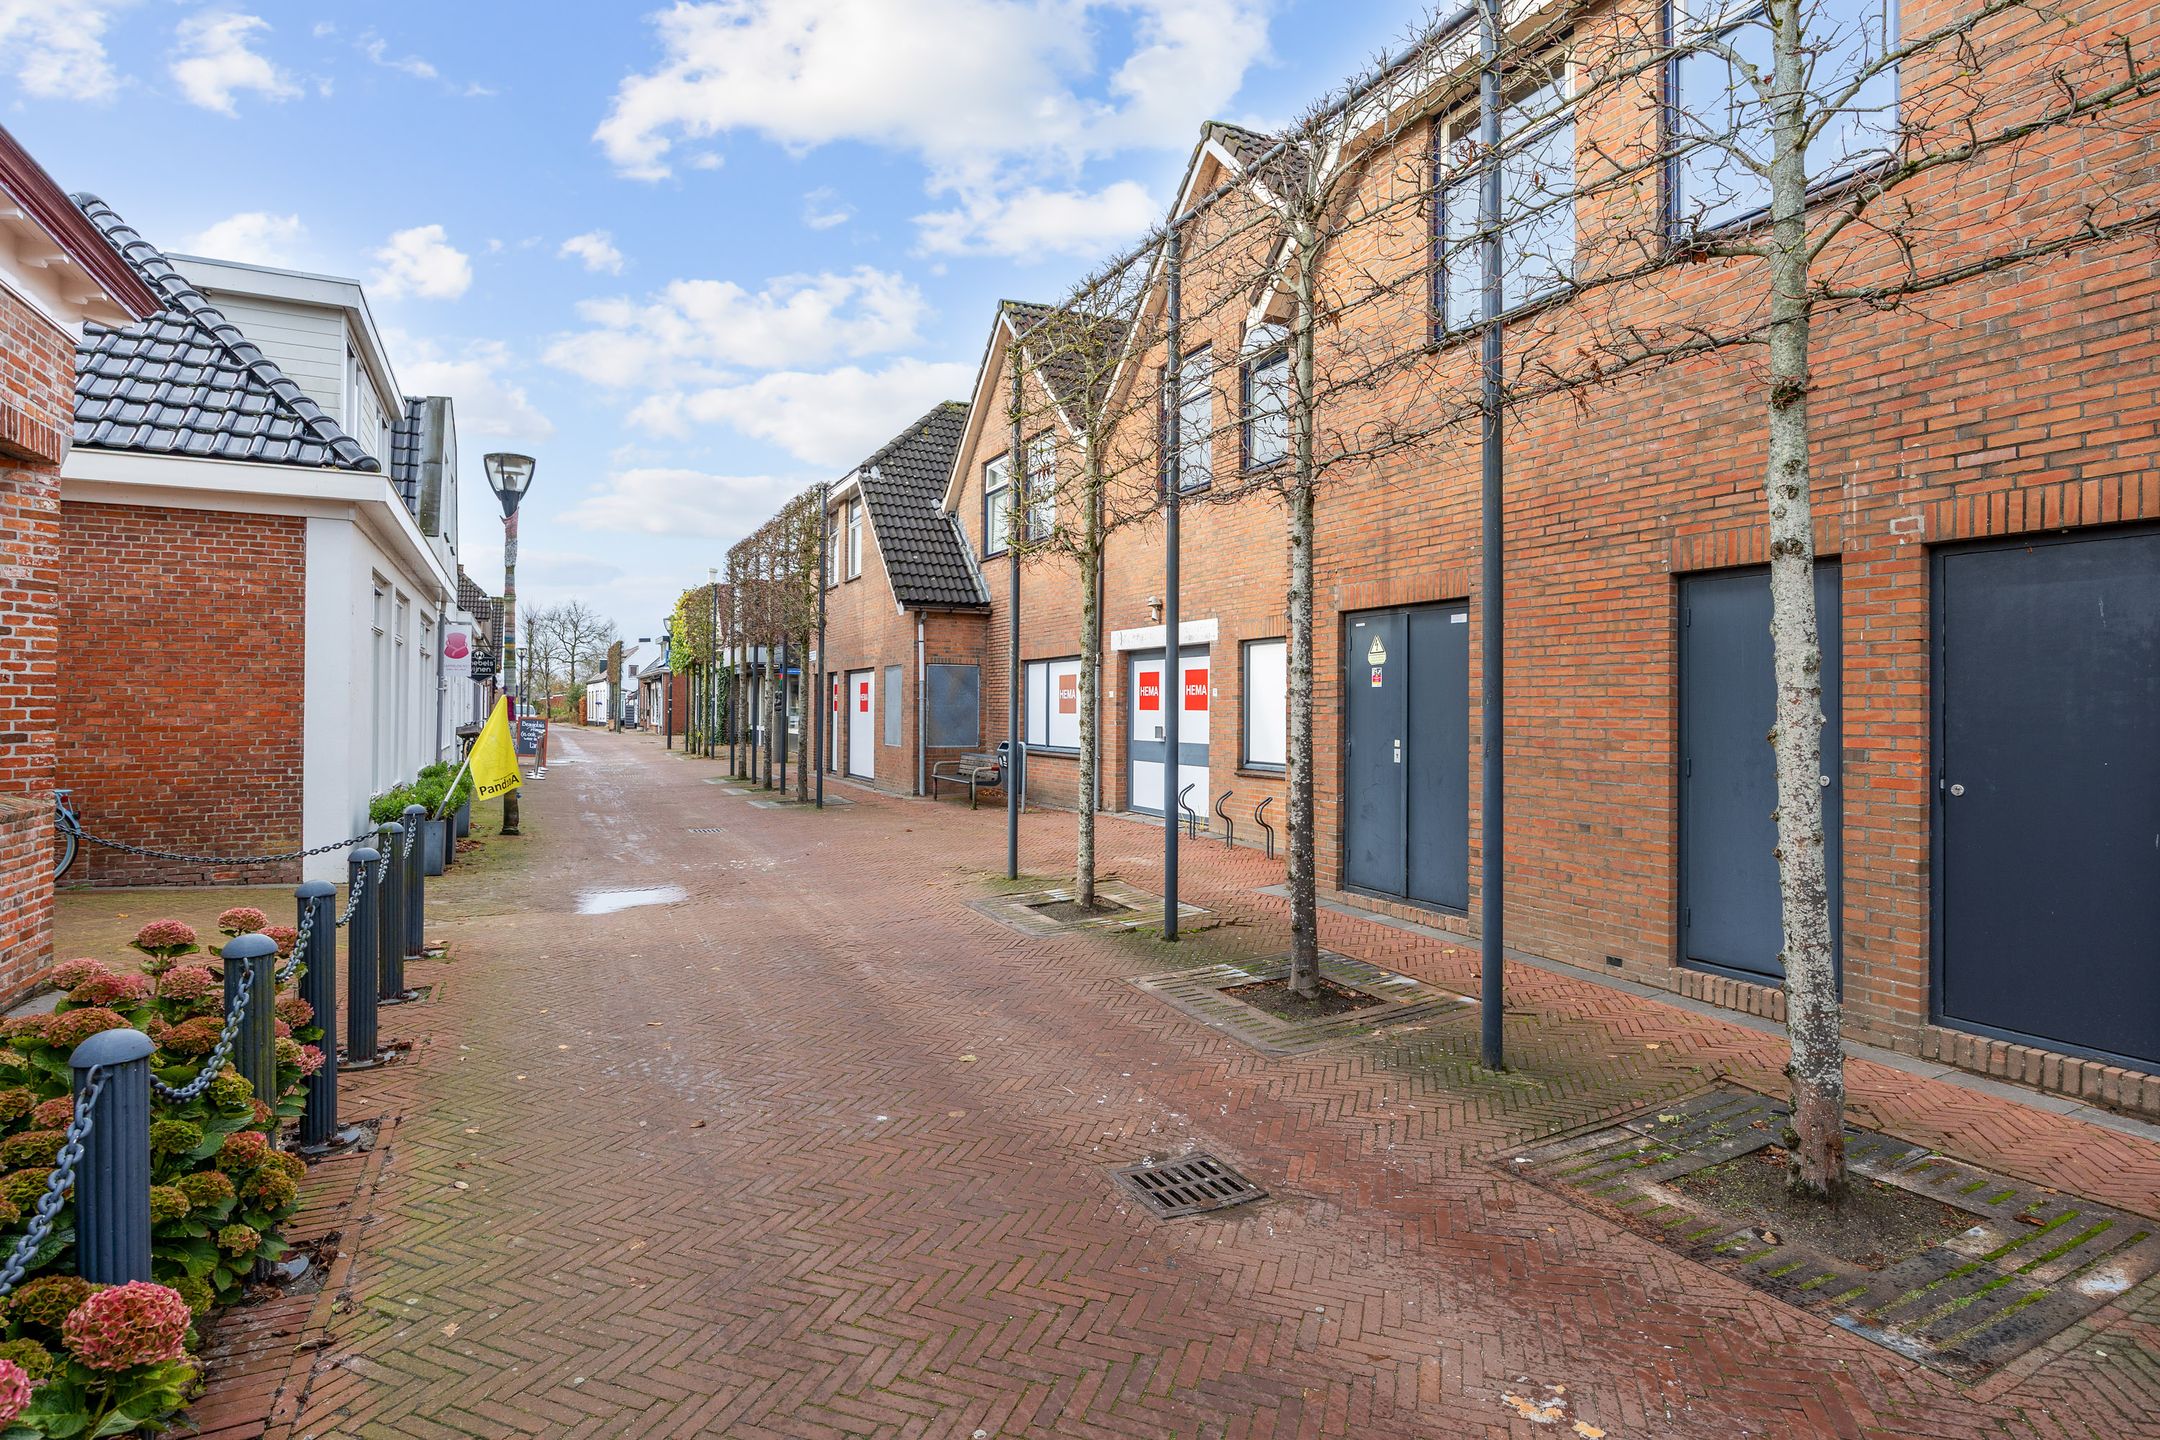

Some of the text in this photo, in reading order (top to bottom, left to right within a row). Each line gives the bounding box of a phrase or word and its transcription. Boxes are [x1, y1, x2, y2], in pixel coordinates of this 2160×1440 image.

[1060, 688, 1076, 700] HEMA
[1140, 686, 1159, 697] HEMA
[1185, 685, 1208, 696] HEMA
